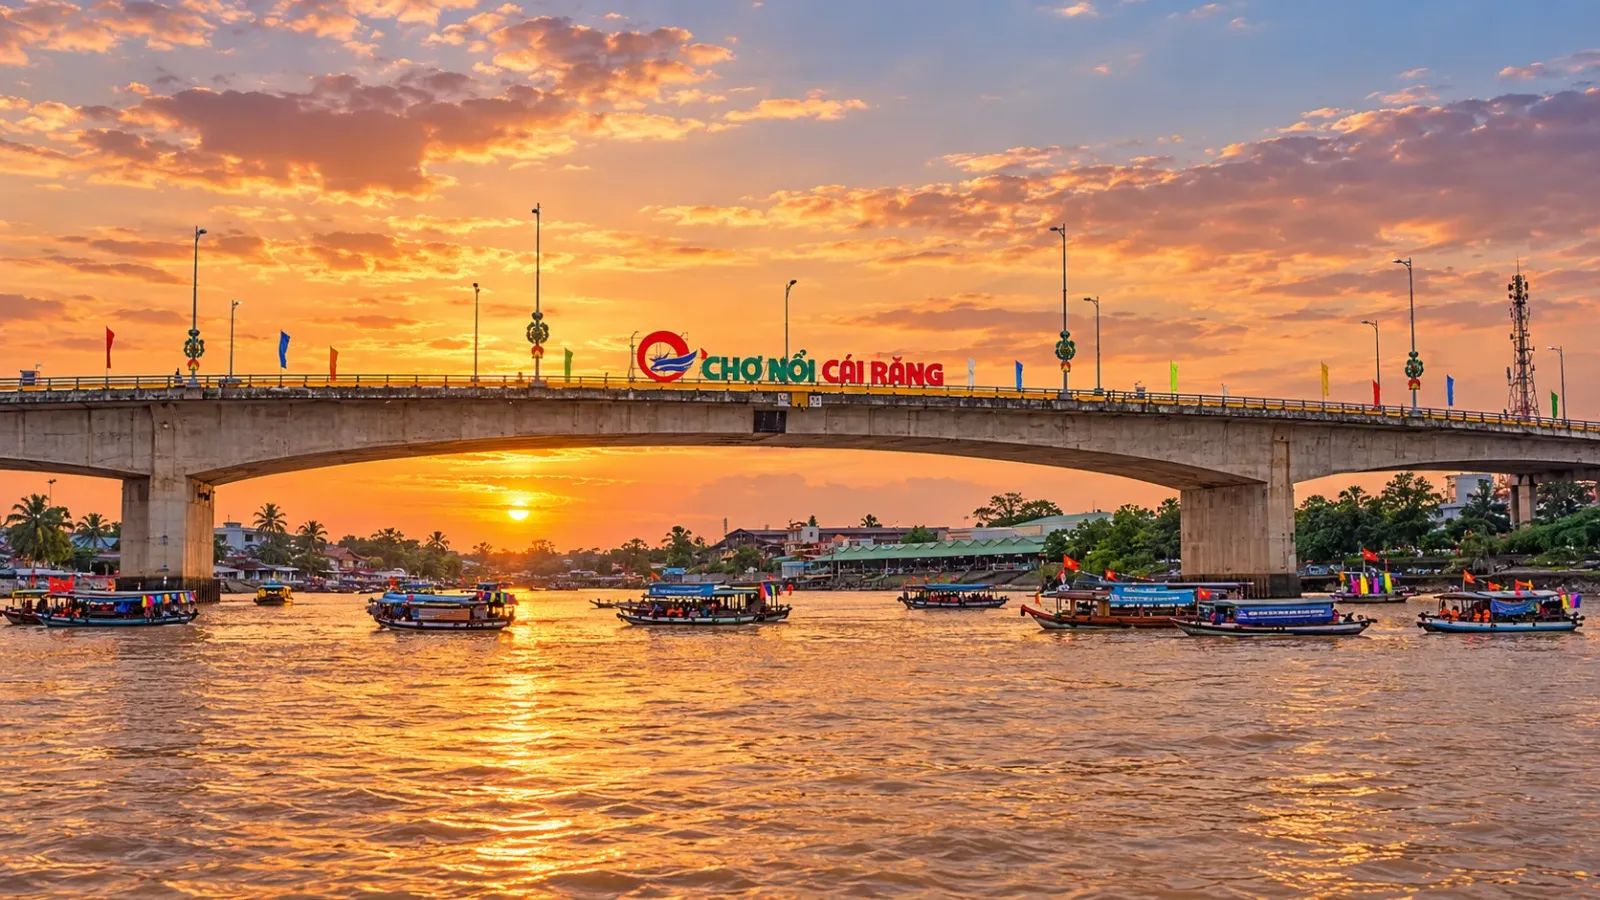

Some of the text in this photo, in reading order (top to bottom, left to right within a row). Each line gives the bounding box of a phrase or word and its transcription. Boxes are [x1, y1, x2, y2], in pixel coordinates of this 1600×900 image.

[768, 349, 816, 382] NỔI
[822, 354, 864, 384] CÁI
[871, 356, 945, 387] RĂNG
